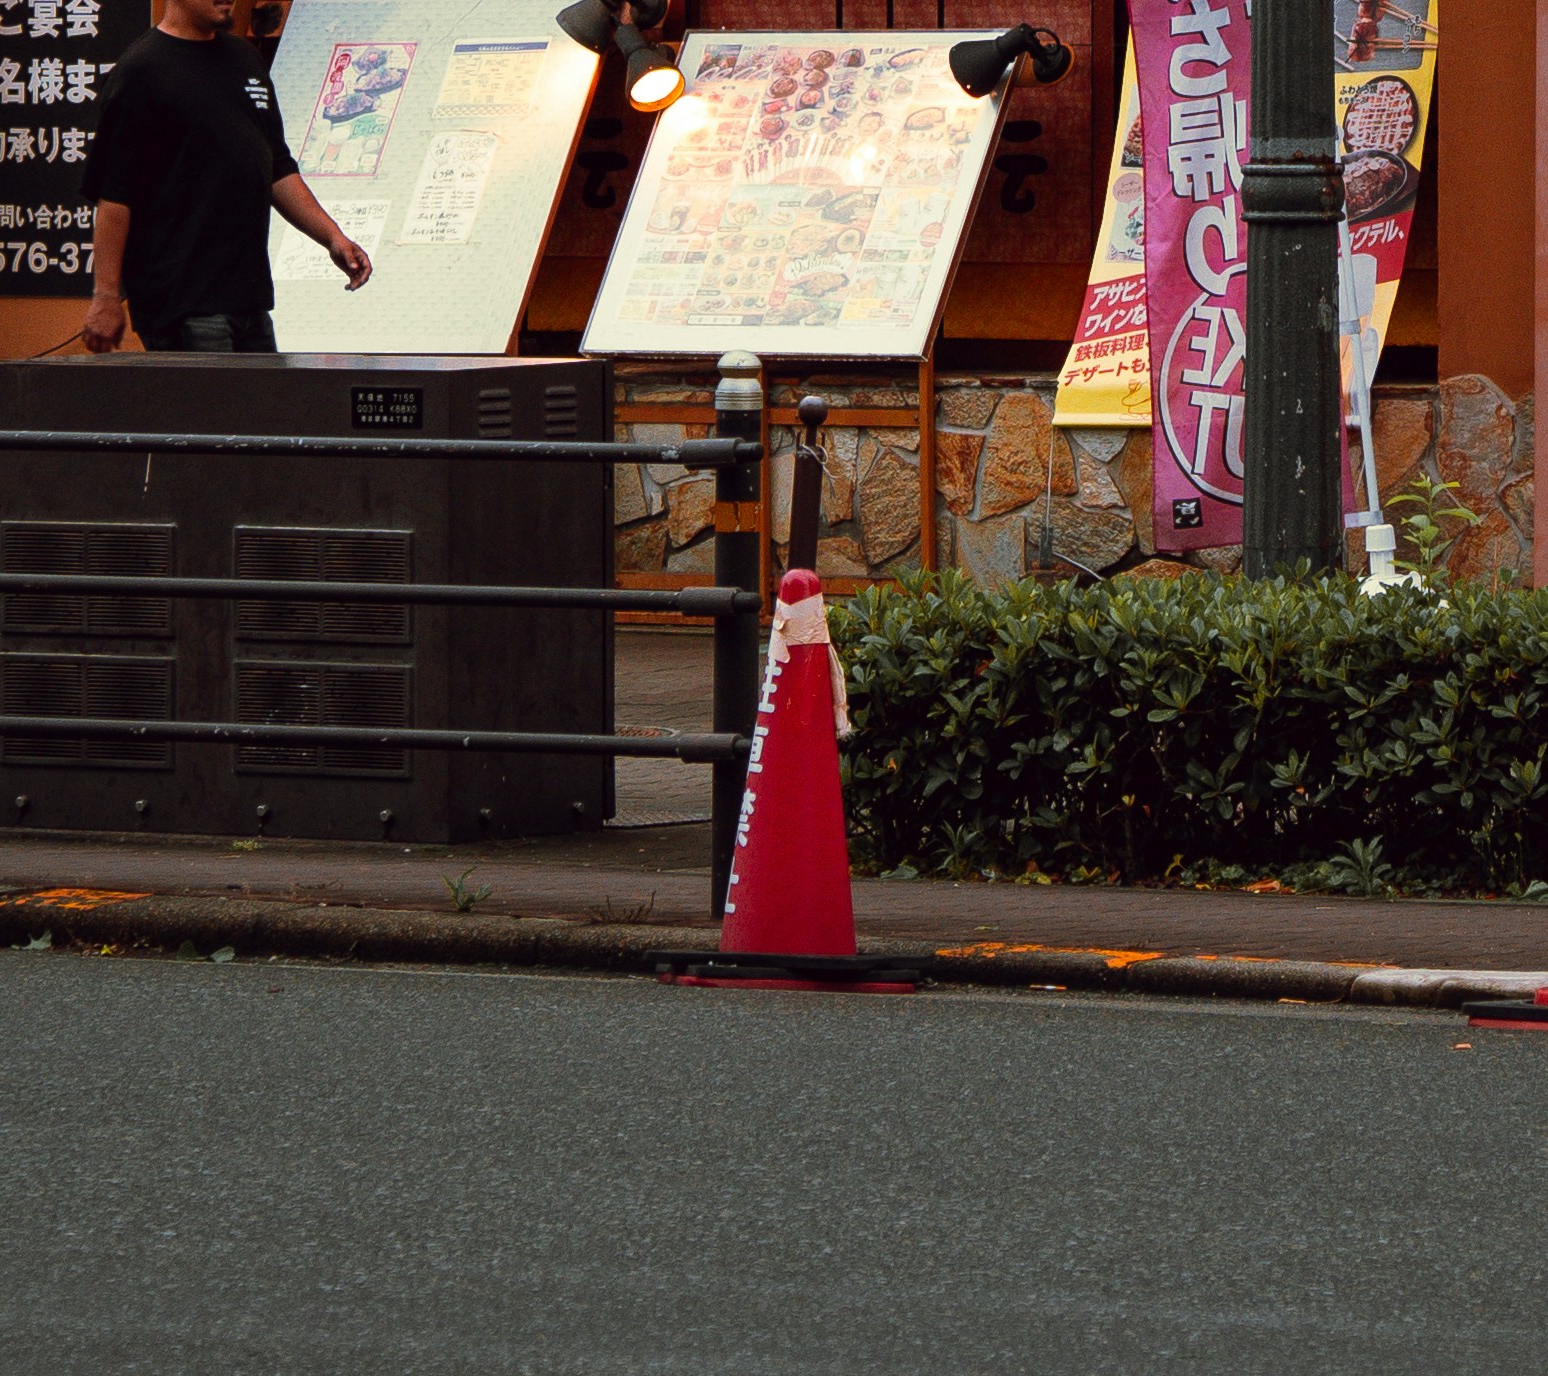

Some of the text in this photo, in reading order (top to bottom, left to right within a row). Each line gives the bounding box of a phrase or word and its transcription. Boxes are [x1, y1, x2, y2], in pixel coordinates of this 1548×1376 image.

[1064, 357, 1151, 387] デザートも
